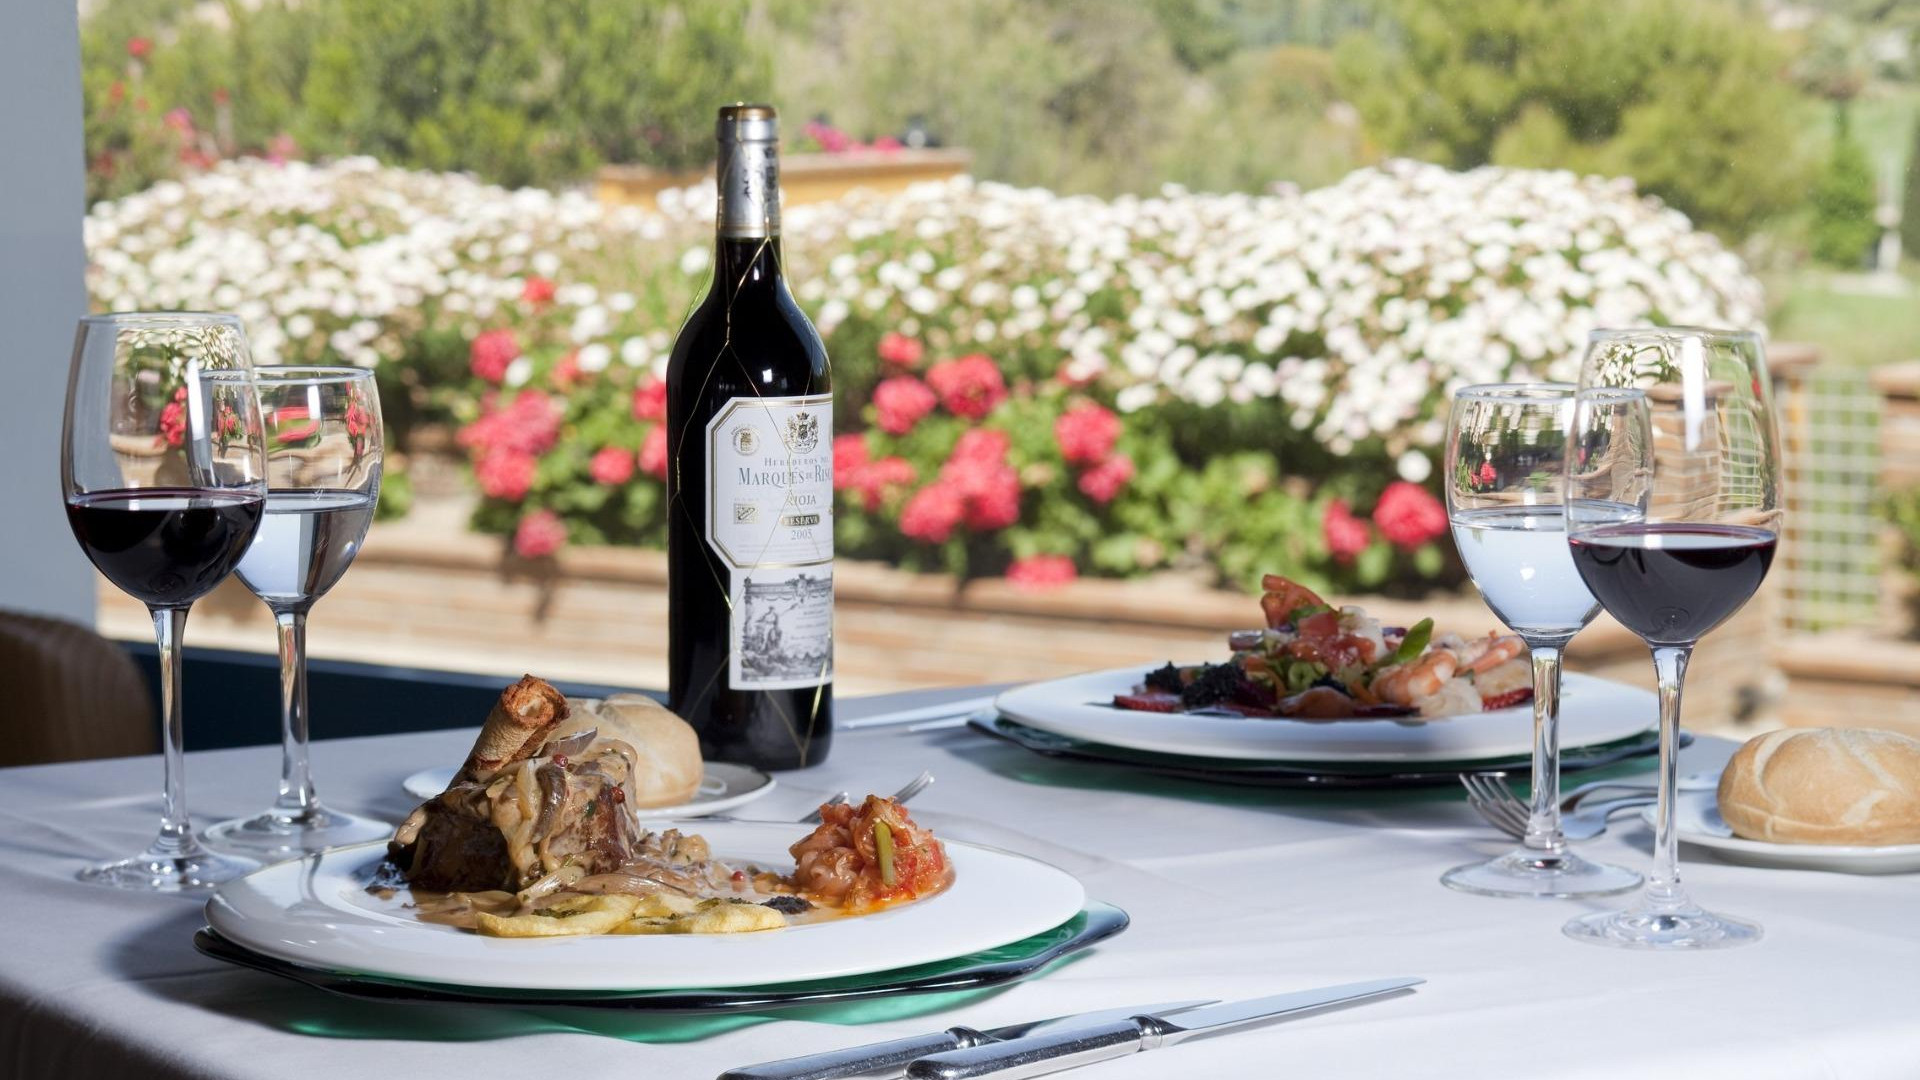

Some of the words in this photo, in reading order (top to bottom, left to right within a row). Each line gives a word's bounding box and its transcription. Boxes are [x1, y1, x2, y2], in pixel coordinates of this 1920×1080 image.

[815, 464, 832, 482] RISC
[785, 494, 817, 506] RIOJA
[791, 529, 812, 541] 2005
